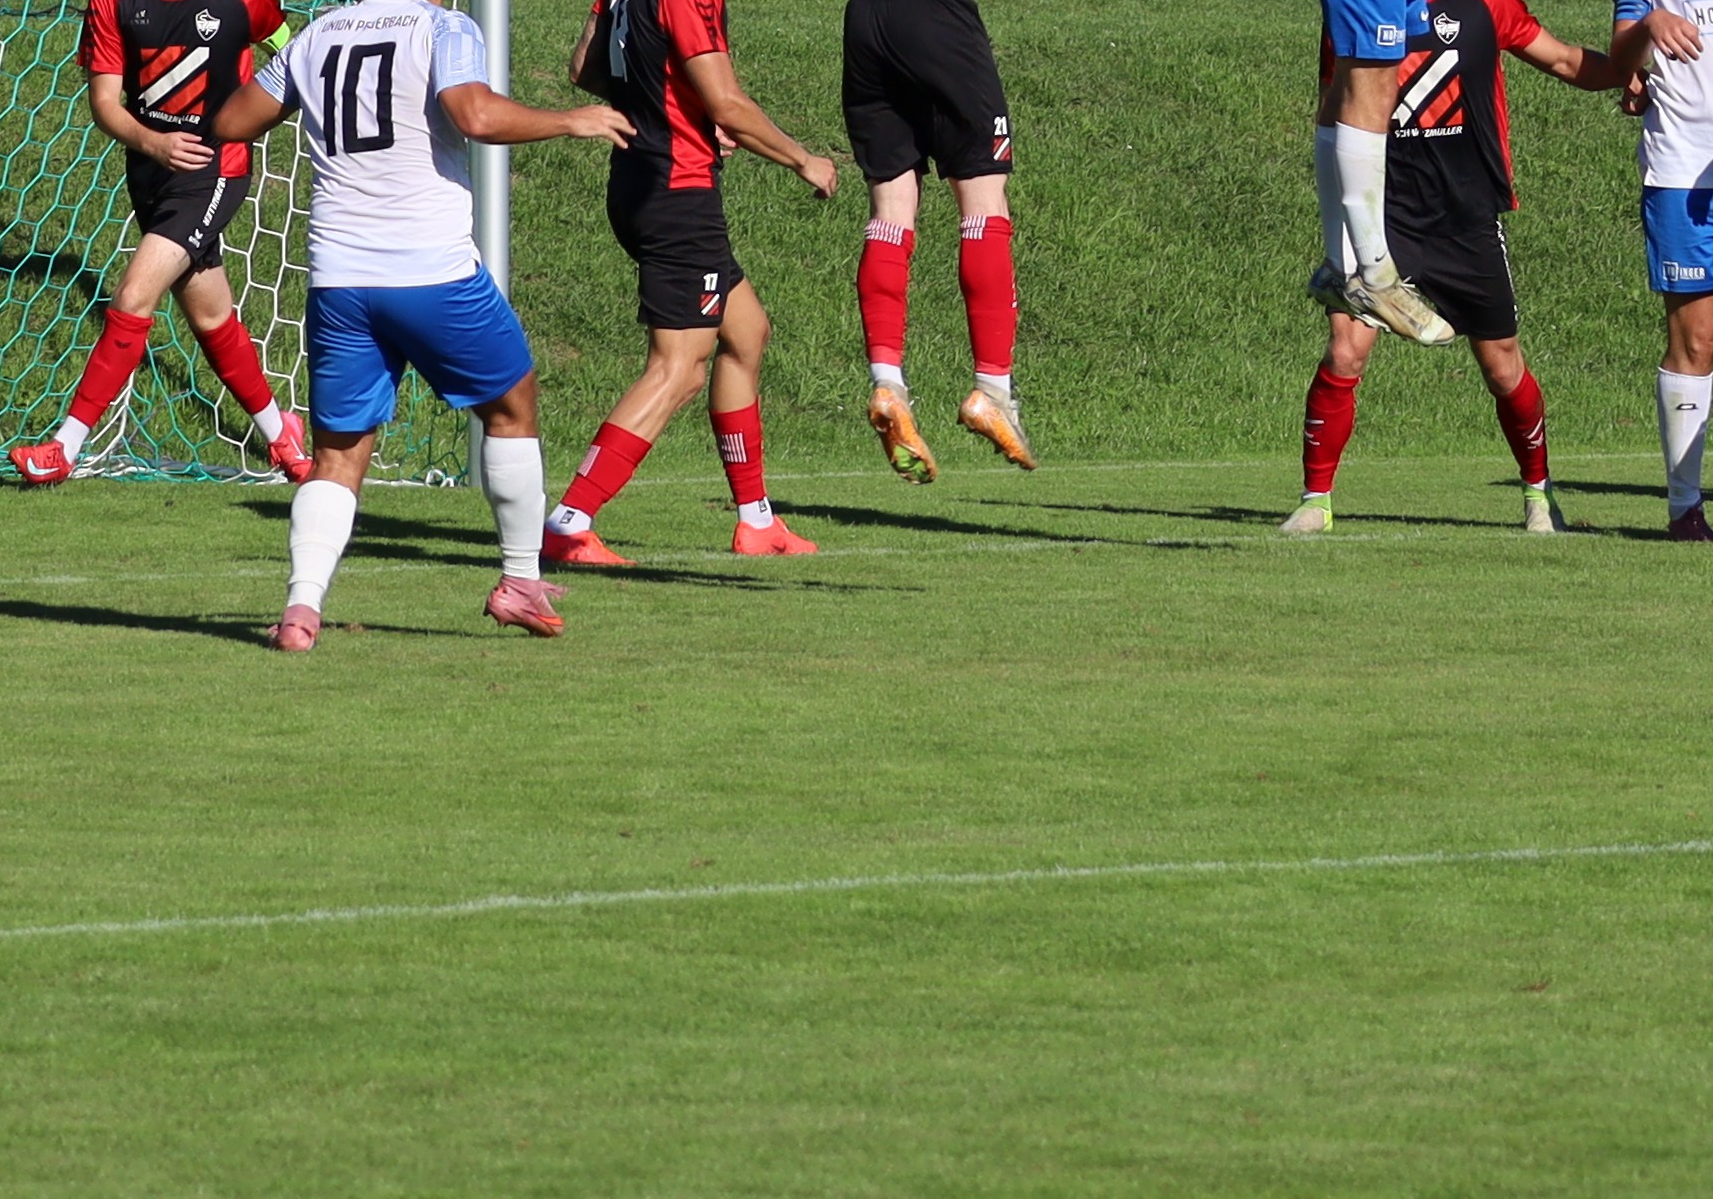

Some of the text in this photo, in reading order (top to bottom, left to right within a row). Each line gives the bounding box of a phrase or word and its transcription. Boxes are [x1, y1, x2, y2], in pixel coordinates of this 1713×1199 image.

[319, 41, 397, 157] 10
[993, 115, 1008, 136] 21
[702, 272, 719, 292] 17
